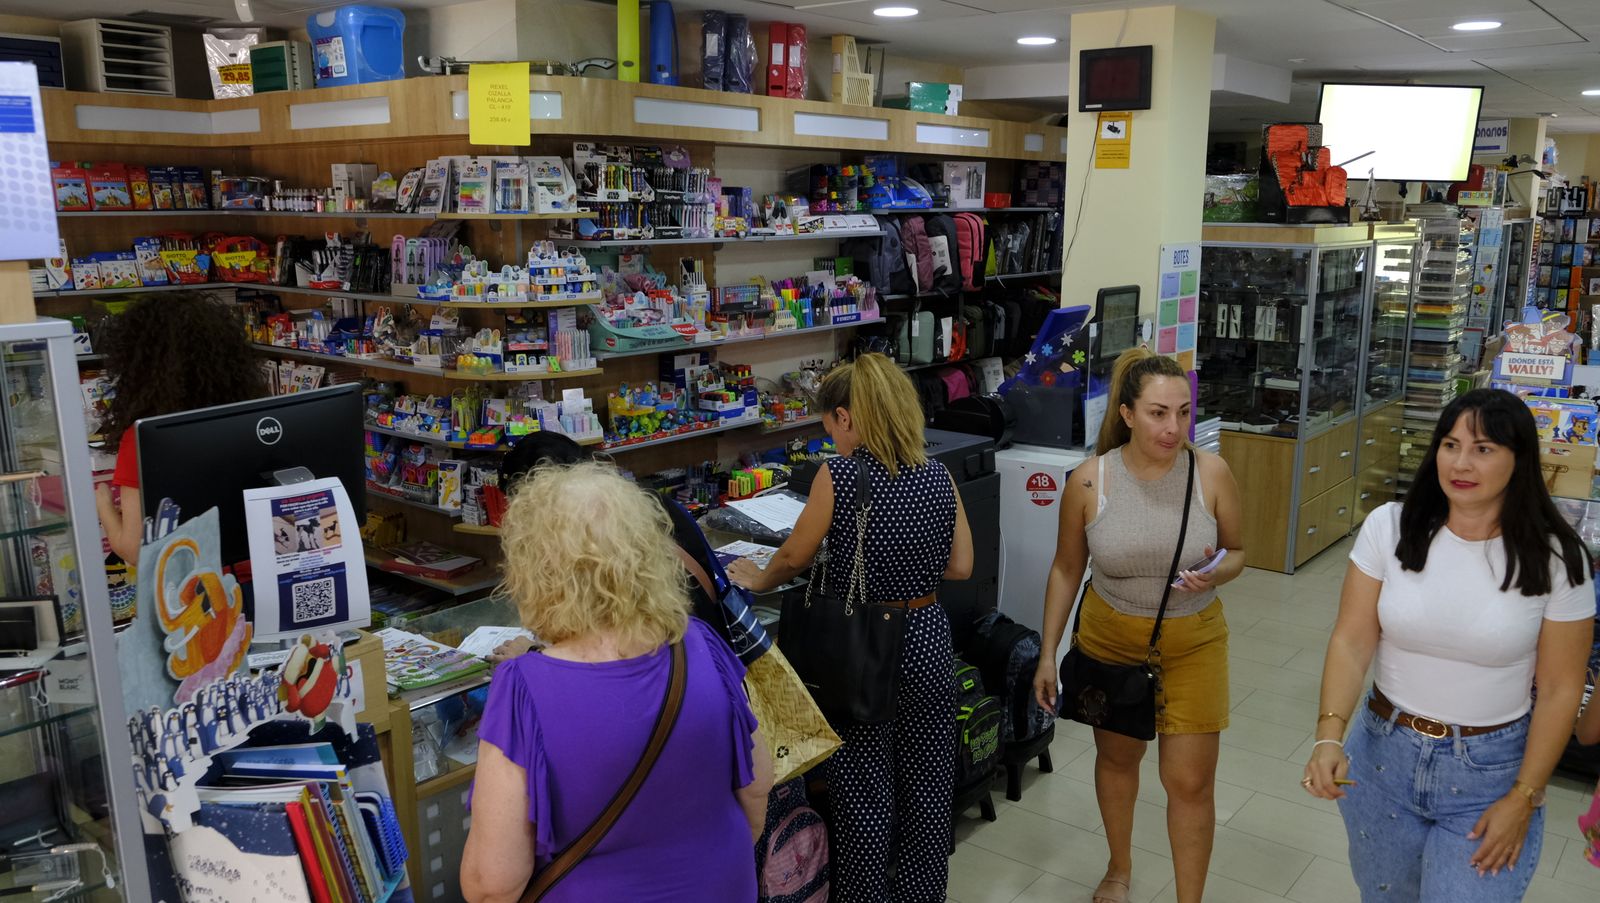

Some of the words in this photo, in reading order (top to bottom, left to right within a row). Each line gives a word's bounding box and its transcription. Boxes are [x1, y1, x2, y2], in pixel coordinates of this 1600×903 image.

[222, 71, 250, 83] 29,85
[1173, 249, 1190, 265] BOTES
[1538, 357, 1555, 365] ESTÁ
[1508, 364, 1554, 375] WALLY?
[260, 425, 280, 436] DELL
[1032, 475, 1050, 487] +18
